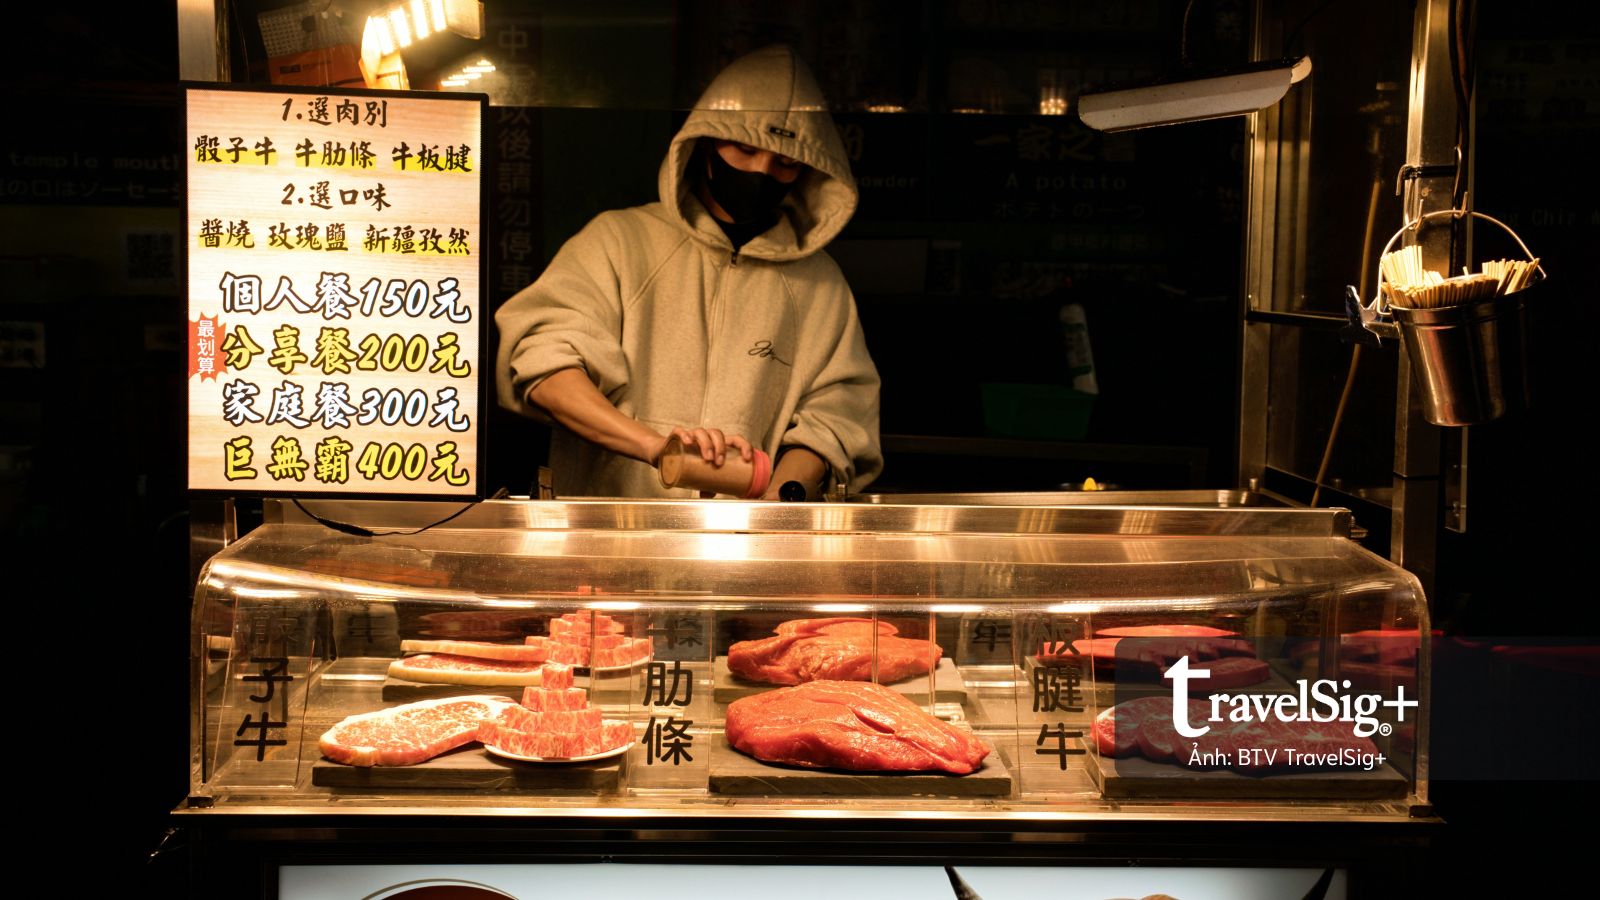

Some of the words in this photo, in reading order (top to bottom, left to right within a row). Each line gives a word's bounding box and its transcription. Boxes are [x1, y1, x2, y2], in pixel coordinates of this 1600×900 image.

[281, 97, 388, 128] 1.選肉別
[195, 135, 277, 166] 骰子牛
[295, 138, 377, 168] 牛肋條
[392, 141, 472, 172] 牛板腱
[281, 181, 391, 212] 2.選口味
[1036, 172, 1128, 191] potato
[200, 218, 255, 249] 醬燒
[268, 222, 349, 251] 玫瑰鹽
[363, 224, 471, 256] 新疆孜然
[220, 271, 472, 323] 個人餐150元
[197, 319, 216, 374] 最划算
[221, 324, 472, 377] 分享餐200元
[222, 379, 471, 432] 家庭餐300元
[223, 435, 470, 486] 巨無霸400元
